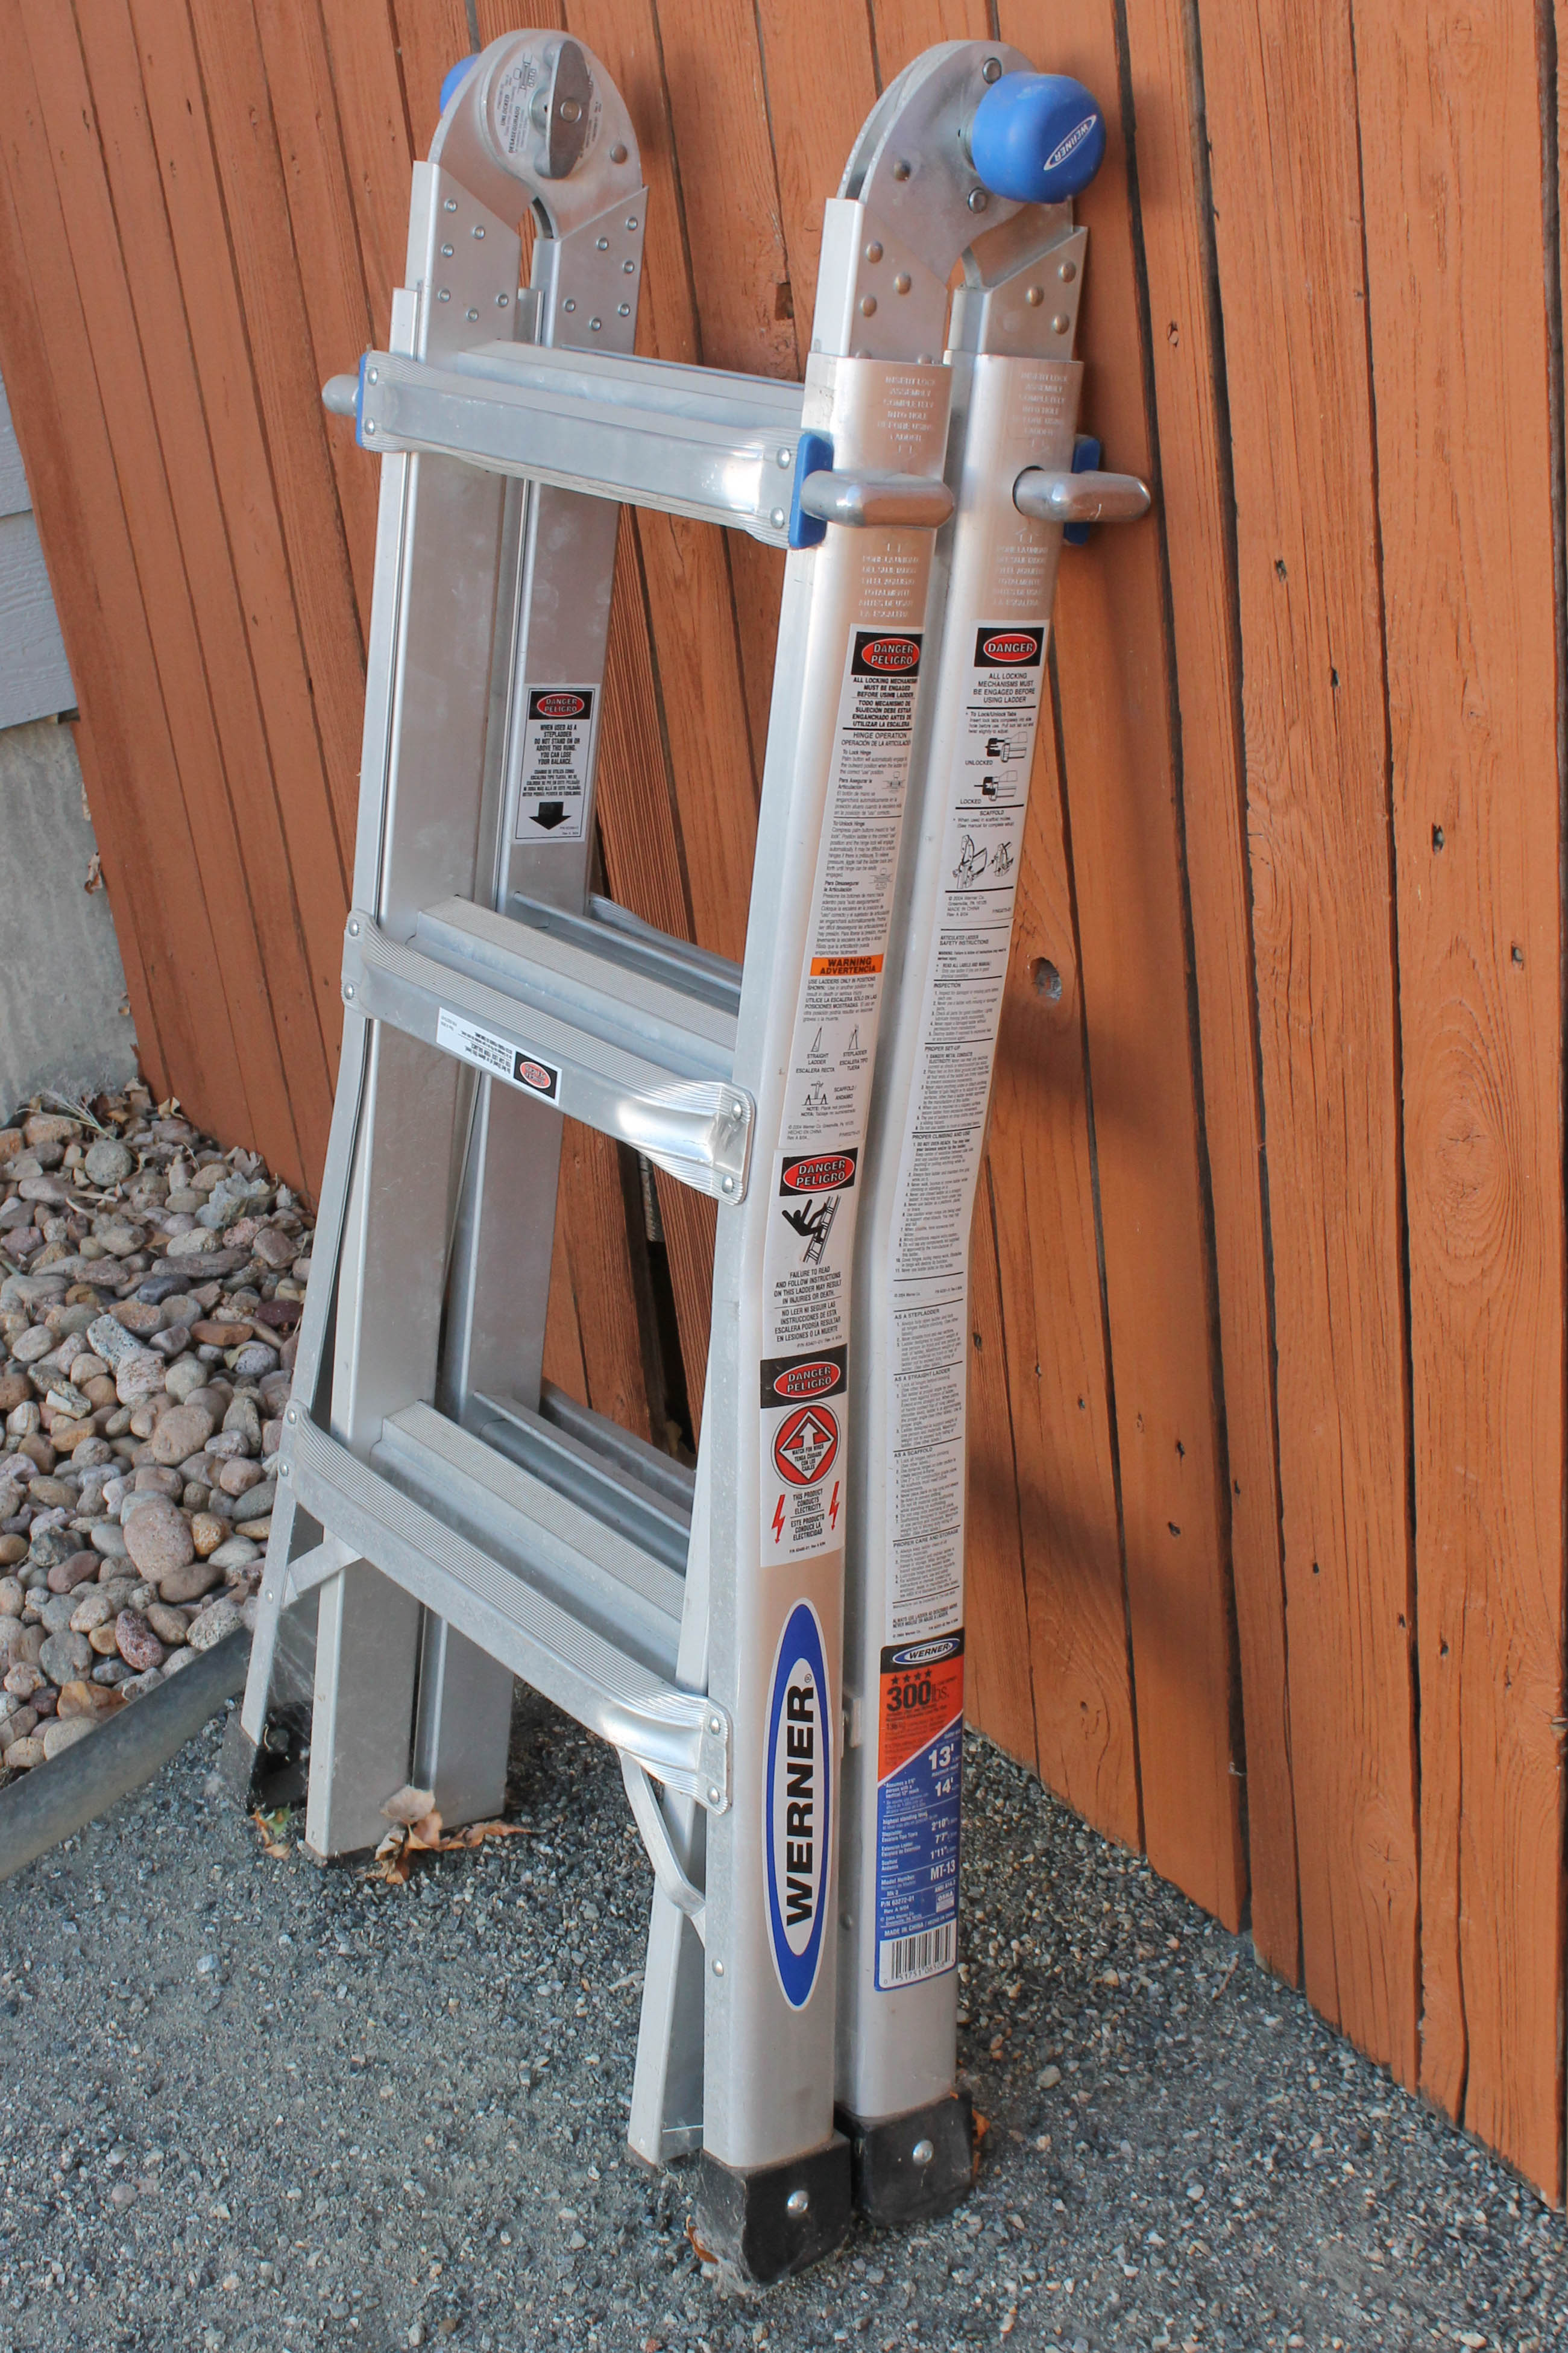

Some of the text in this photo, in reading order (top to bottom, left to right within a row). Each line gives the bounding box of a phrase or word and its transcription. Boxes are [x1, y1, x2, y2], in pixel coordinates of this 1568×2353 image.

[502, 95, 510, 126] UNLOCKED
[508, 106, 520, 153] DESASEGURADO
[1054, 123, 1088, 162] WERNER
[874, 644, 913, 653] DANGER
[988, 643, 1033, 652] DANGER
[871, 655, 913, 664] PELIGRO
[828, 958, 872, 967] WARNING
[799, 1160, 845, 1174] DANGER
[796, 1171, 845, 1186] PELIGRO
[788, 1278, 808, 1287] FOLLOW
[810, 1272, 840, 1283] INSTRUCTIONS
[796, 1286, 814, 1294] LADDER
[827, 1280, 842, 1288] RESULT
[790, 1294, 811, 1303] INJURIES
[810, 1303, 827, 1312] SEGUIR
[908, 1309, 939, 1318] STEPLADDER
[775, 1316, 840, 1334] ESCALERA RESULTAR
[781, 1313, 818, 1325] INSTRUCCIONES
[786, 1331, 808, 1341] LESIONES
[822, 1325, 837, 1334] MUERTE
[789, 1366, 831, 1382] DANGER
[908, 1371, 931, 1380] STRAIGHT
[787, 1377, 831, 1392] PELIGRO
[907, 1447, 933, 1456] SCAFFOLD
[804, 1488, 823, 1499] PRODUCT
[797, 1497, 819, 1507] CONDUCTS
[795, 1503, 821, 1515] ELECTRICITY
[791, 1514, 824, 1527] ESTE PRODUCTO
[795, 1523, 814, 1533] CONDUCE
[940, 1529, 958, 1538] STORAGE
[793, 1529, 822, 1541] ELECTRICIDAD
[910, 1643, 948, 1659] WERNER
[887, 1681, 931, 1711] 300
[929, 1743, 954, 1770] 13'
[936, 1777, 953, 1796] 14'
[787, 1685, 813, 1926] WERNER
[931, 1860, 956, 1880] MT-13
[938, 1891, 952, 1901] OSHA
[908, 1922, 924, 1931] CHINA
